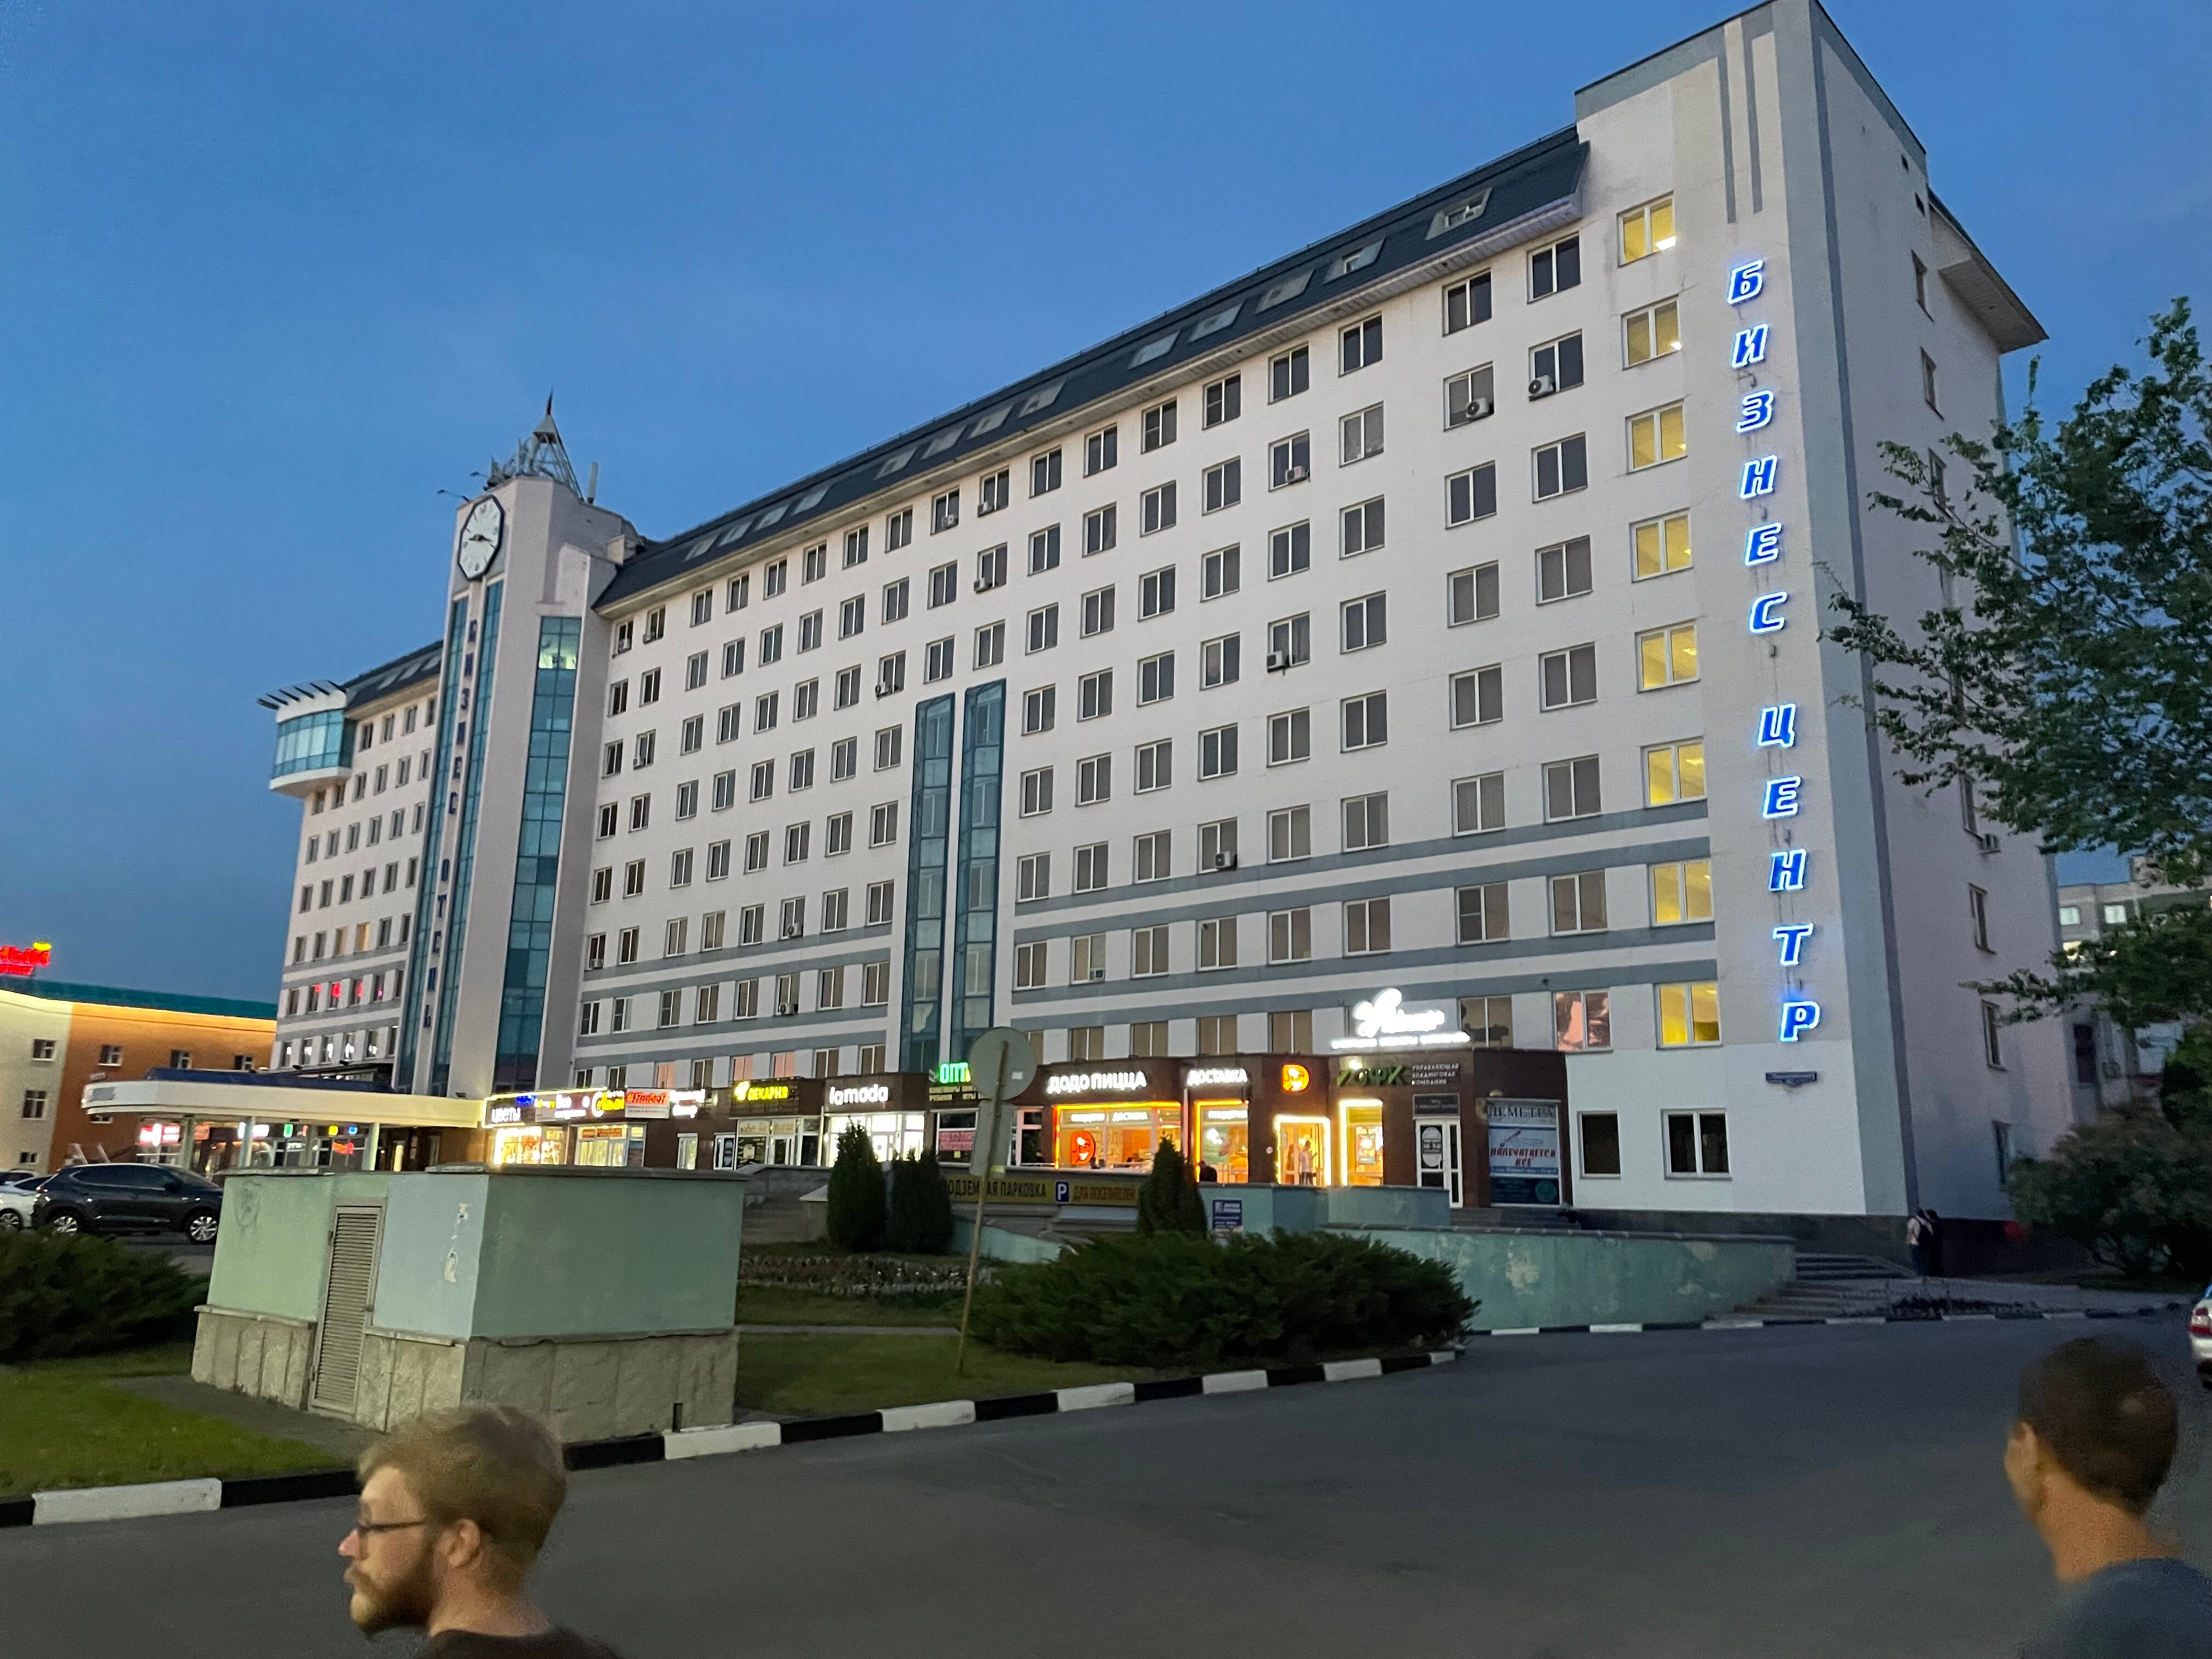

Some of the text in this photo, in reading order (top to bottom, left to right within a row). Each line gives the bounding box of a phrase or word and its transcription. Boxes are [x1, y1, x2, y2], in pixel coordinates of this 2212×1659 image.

[1726, 259, 1821, 1042] БИЗНЕС ЦЕНТР
[1047, 1071, 1147, 1094] ДОДО ПИЦЦА
[1187, 1069, 1248, 1086] ДОСТАВКА
[829, 1083, 889, 1105] lamoda
[945, 1180, 1046, 1197] ОДЗЕМАЯ ПАРКОВКА
